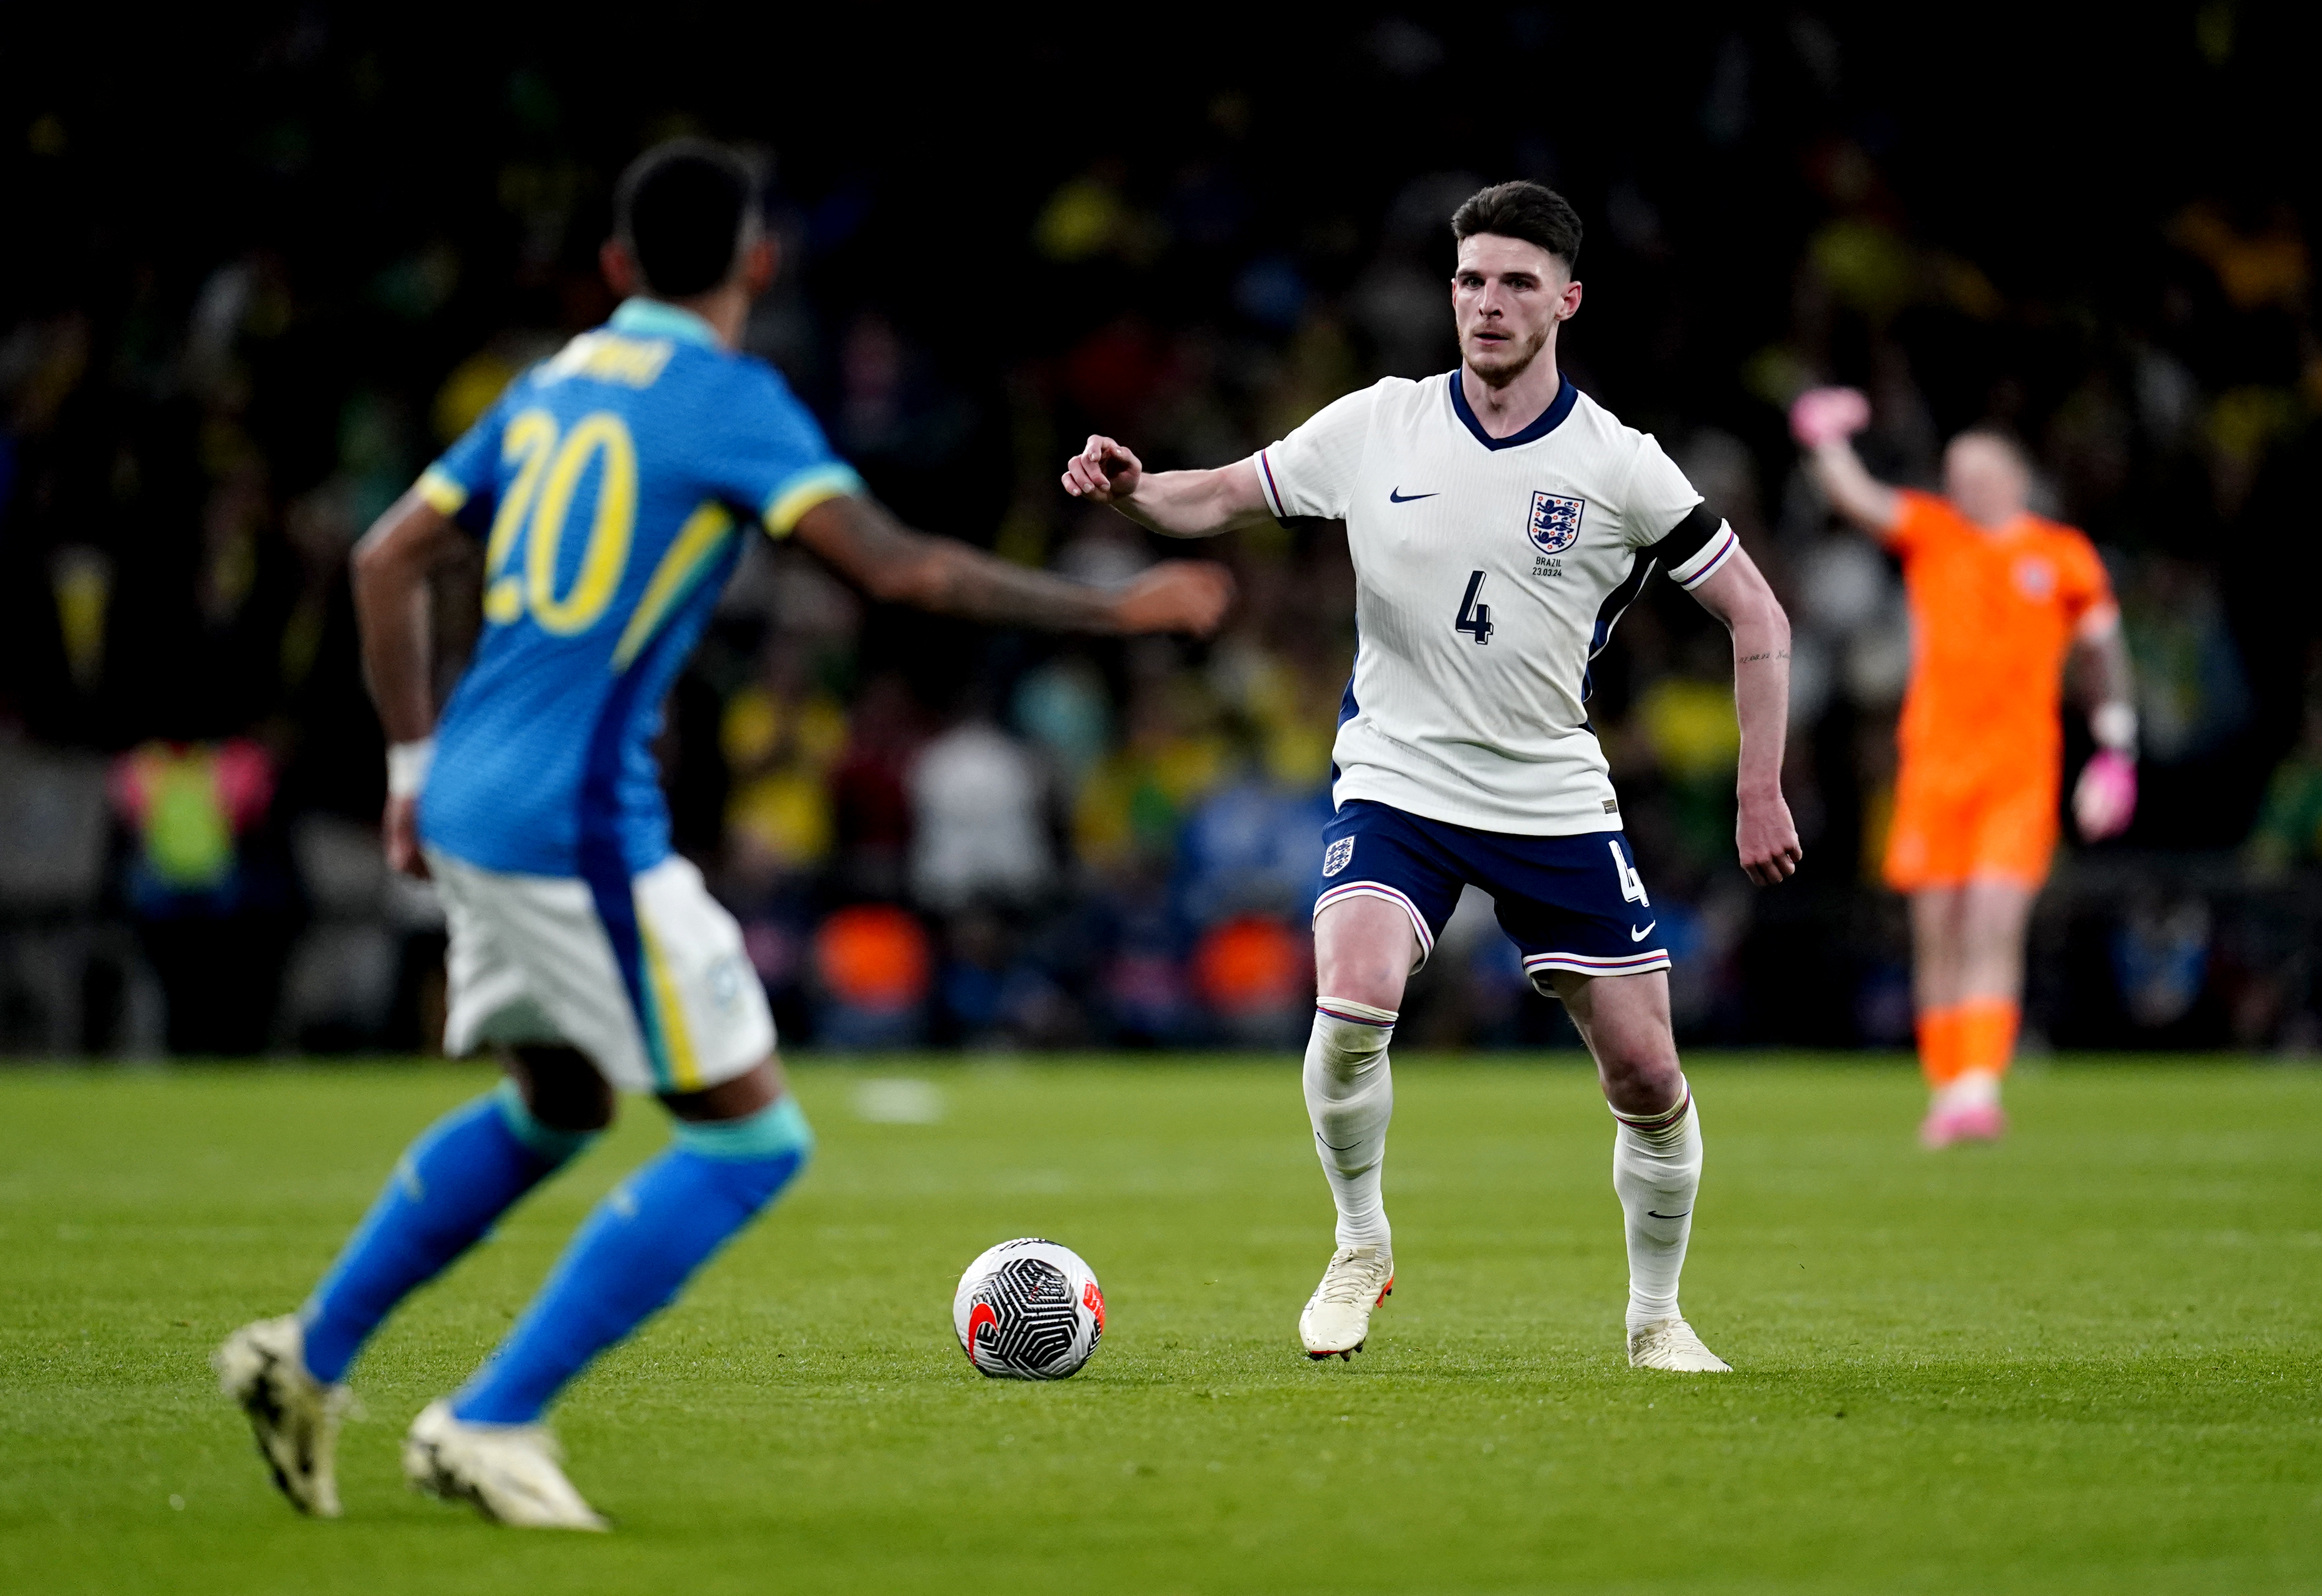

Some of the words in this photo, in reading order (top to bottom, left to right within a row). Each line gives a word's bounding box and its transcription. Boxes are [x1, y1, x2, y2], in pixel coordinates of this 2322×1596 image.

[486, 406, 639, 636] 20
[1532, 567, 1562, 577] 23.03.24
[1536, 556, 1562, 567] BRAZIL
[1455, 570, 1494, 645] 4
[1608, 840, 1650, 908] 4
